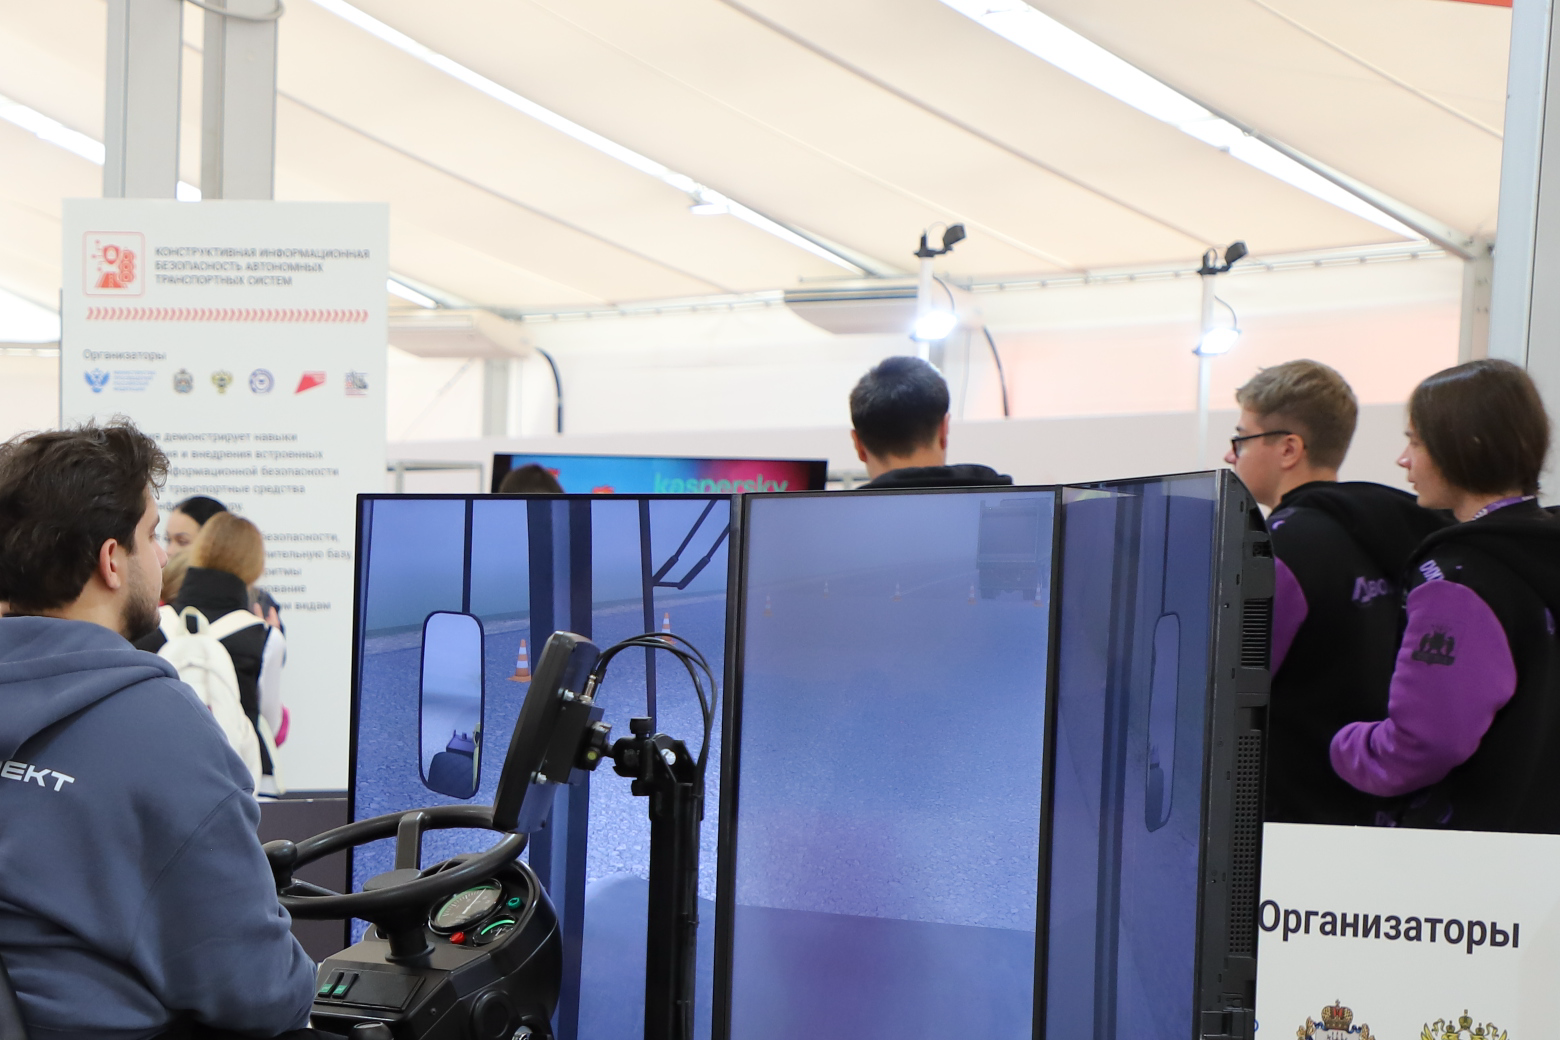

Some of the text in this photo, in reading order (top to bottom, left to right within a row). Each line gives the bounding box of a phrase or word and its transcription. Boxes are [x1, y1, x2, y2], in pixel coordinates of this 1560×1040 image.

[155, 246, 370, 260] КОНСТРУКТИВНАЯ ИНФОРМАЦИОННАЯ
[155, 260, 323, 273] БЕЗОПАСНОСТЬ АВТОНОМНЫХ
[155, 274, 292, 286] ТРАНСПОРТНЫХ СИСТЕМ
[83, 349, 167, 361] Организаторы
[163, 432, 251, 443] демонстрирует
[254, 433, 298, 441] навыки
[191, 450, 253, 461] внедрения
[255, 450, 324, 461] встроенных
[261, 466, 340, 476] безопасности
[653, 472, 789, 493] kaspersky
[169, 485, 251, 495] транспортные
[253, 485, 306, 495] средства
[1258, 899, 1520, 955] Организаторы
